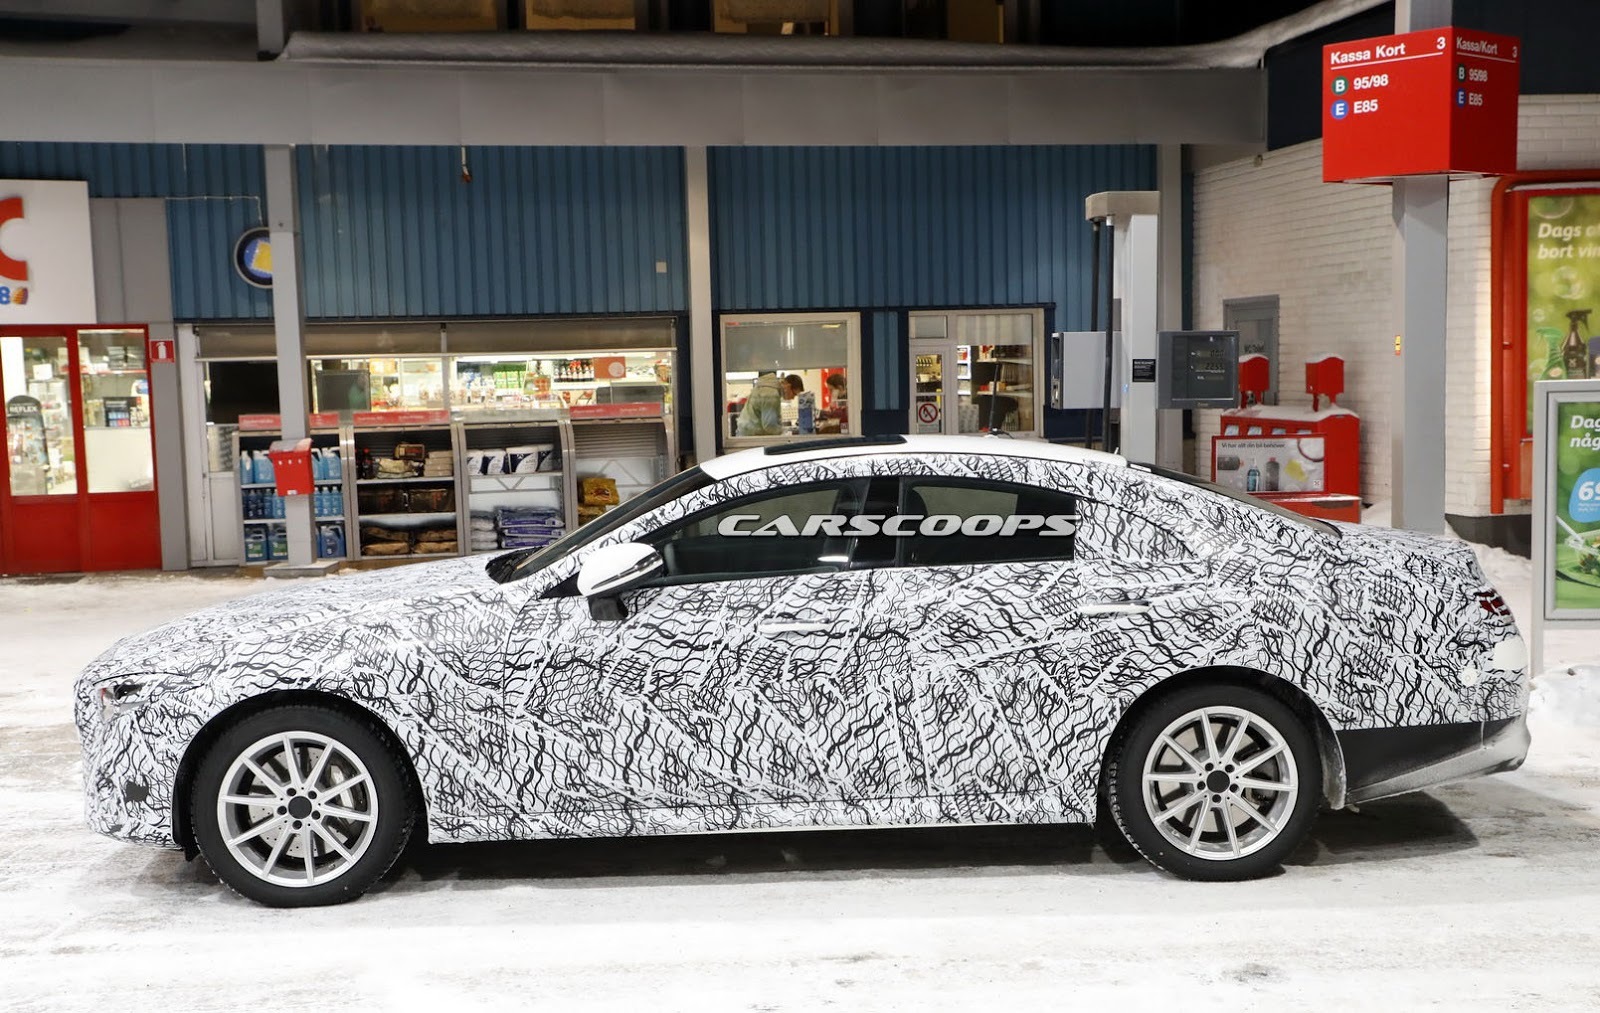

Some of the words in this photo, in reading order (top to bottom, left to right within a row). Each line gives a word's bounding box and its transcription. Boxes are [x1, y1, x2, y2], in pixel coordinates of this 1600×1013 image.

[1330, 48, 1371, 65] Kassa
[1375, 42, 1406, 58] Kort
[1436, 36, 1446, 50] 3
[1456, 36, 1498, 55] Kassa/Kort
[1512, 46, 1518, 58] 3
[1458, 66, 1465, 79] B
[1335, 79, 1345, 92] B
[1353, 74, 1389, 90] 95/98
[1458, 91, 1464, 104] E
[1468, 93, 1483, 106] E85
[1335, 103, 1345, 116] E
[1353, 99, 1378, 114] E85
[1538, 223, 1581, 241] Dags
[1537, 243, 1573, 259] bort
